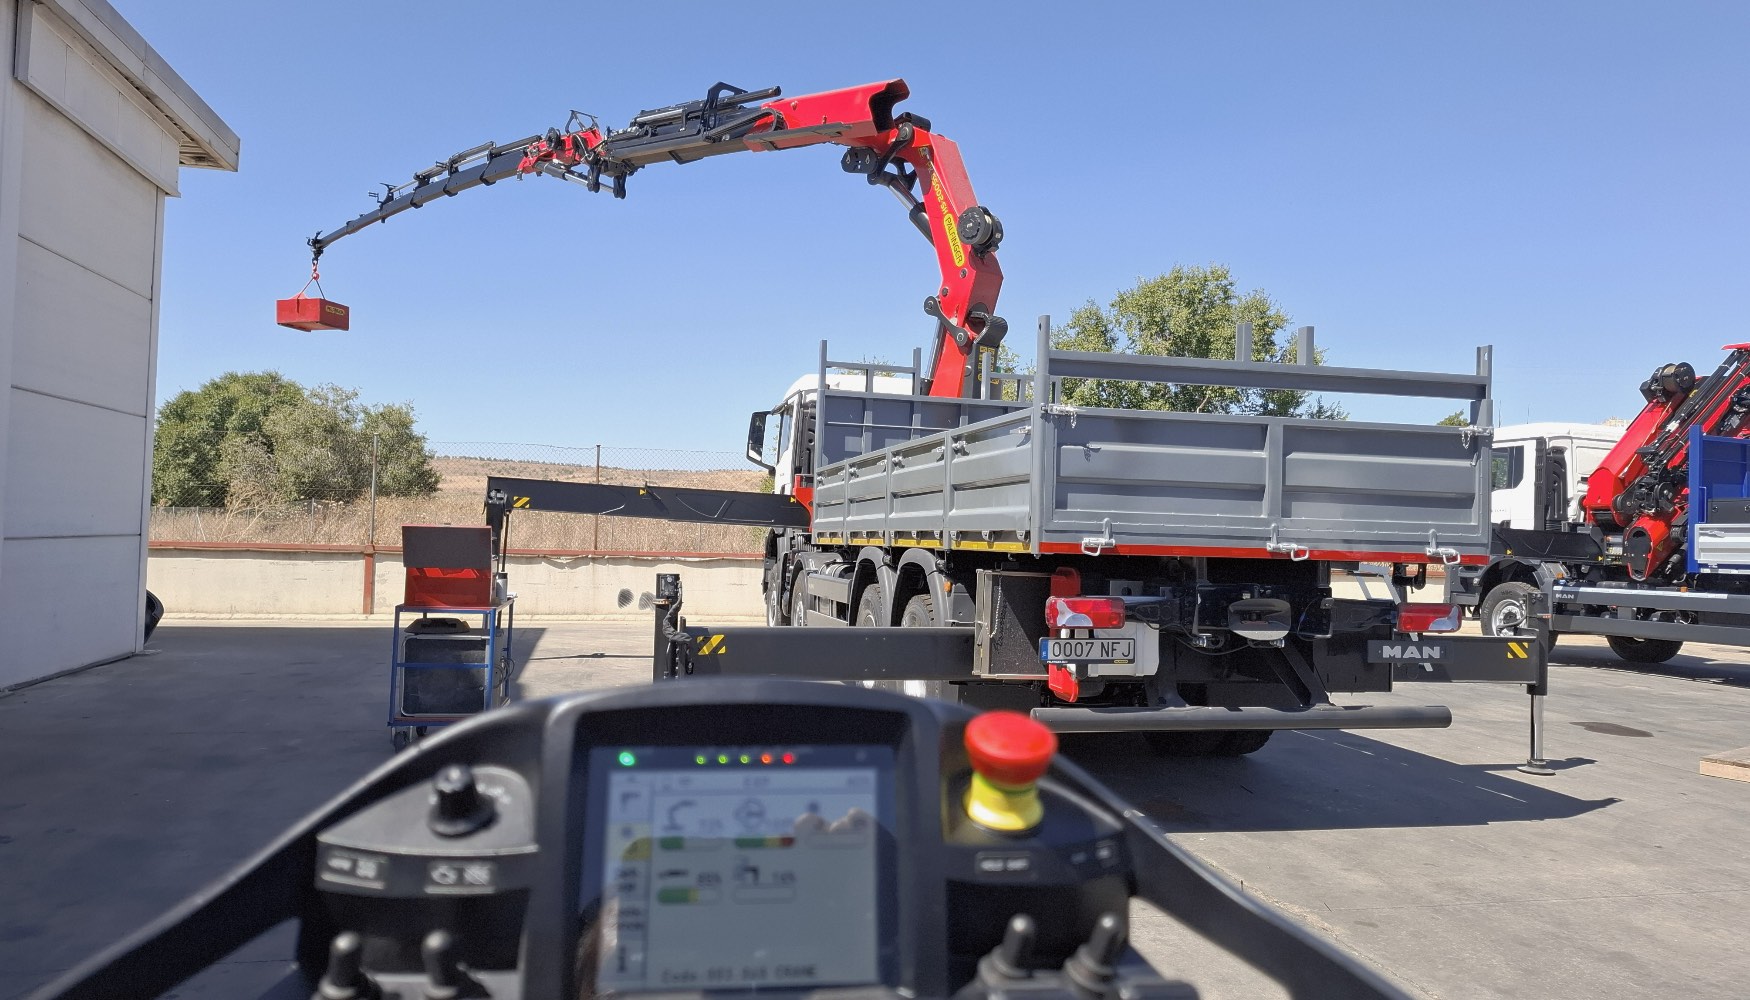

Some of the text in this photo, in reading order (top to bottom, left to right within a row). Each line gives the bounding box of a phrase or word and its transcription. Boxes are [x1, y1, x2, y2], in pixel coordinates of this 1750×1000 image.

[944, 216, 964, 264] PALFINGER
[1052, 641, 1095, 658] 0007
[1100, 641, 1131, 658] NFJ
[1382, 645, 1441, 659] MAN
